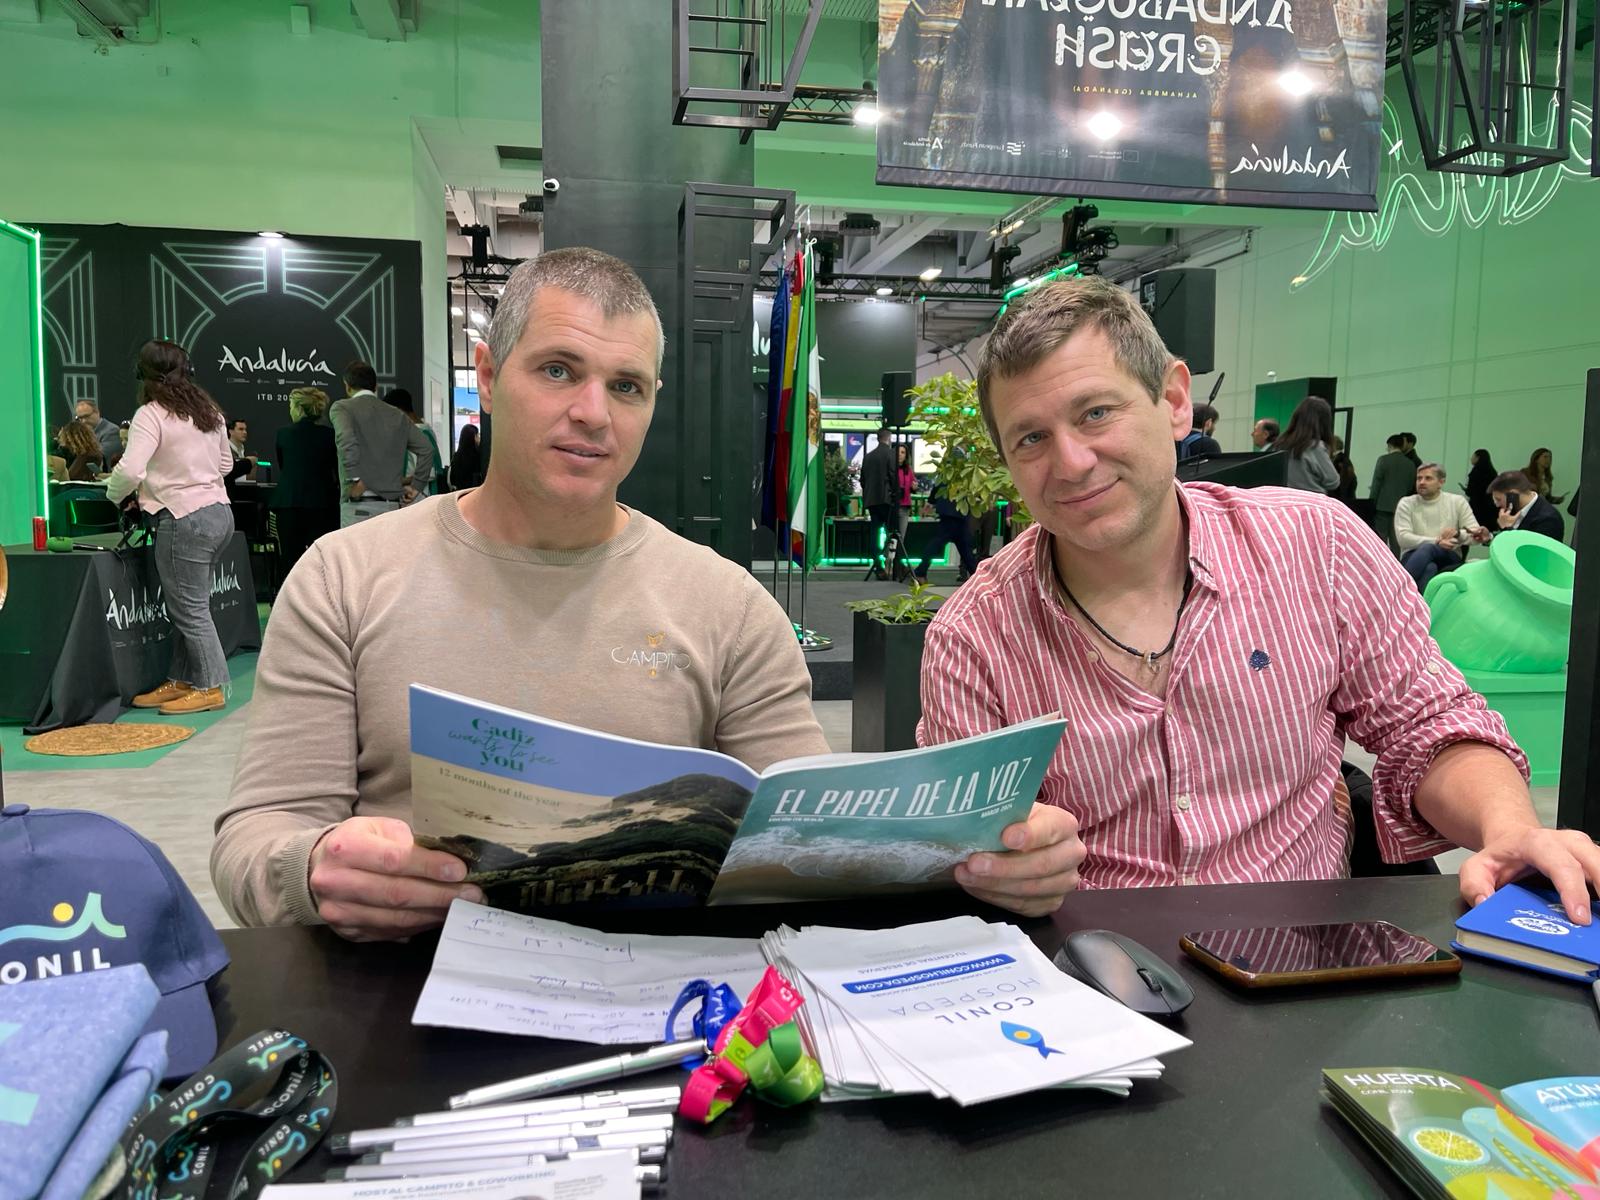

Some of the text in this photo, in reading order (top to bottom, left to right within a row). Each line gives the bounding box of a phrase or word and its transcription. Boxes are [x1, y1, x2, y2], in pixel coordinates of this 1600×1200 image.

[218, 345, 336, 376] Andalucía
[257, 393, 273, 401] ITB
[480, 751, 524, 773] you
[439, 767, 560, 808] 12 months of the year
[774, 756, 1033, 817] EL PAPEL DE LA VOZ
[0, 948, 111, 985] ONIL
[855, 957, 1004, 991] WWW.CONILHOSPEDA.COM
[888, 977, 1040, 1016] HOSPEDA
[935, 996, 1035, 1024] CONIL
[169, 1075, 216, 1110] CONIL
[259, 1051, 310, 1116] oconil.es
[1343, 1073, 1461, 1090] HUERTA
[259, 1124, 291, 1156] CONIL
[193, 1145, 210, 1175] CONIL
[353, 1187, 402, 1197] HOSTAL
[407, 1180, 463, 1192] CAMPITO
[478, 1169, 556, 1186] COWORKING
